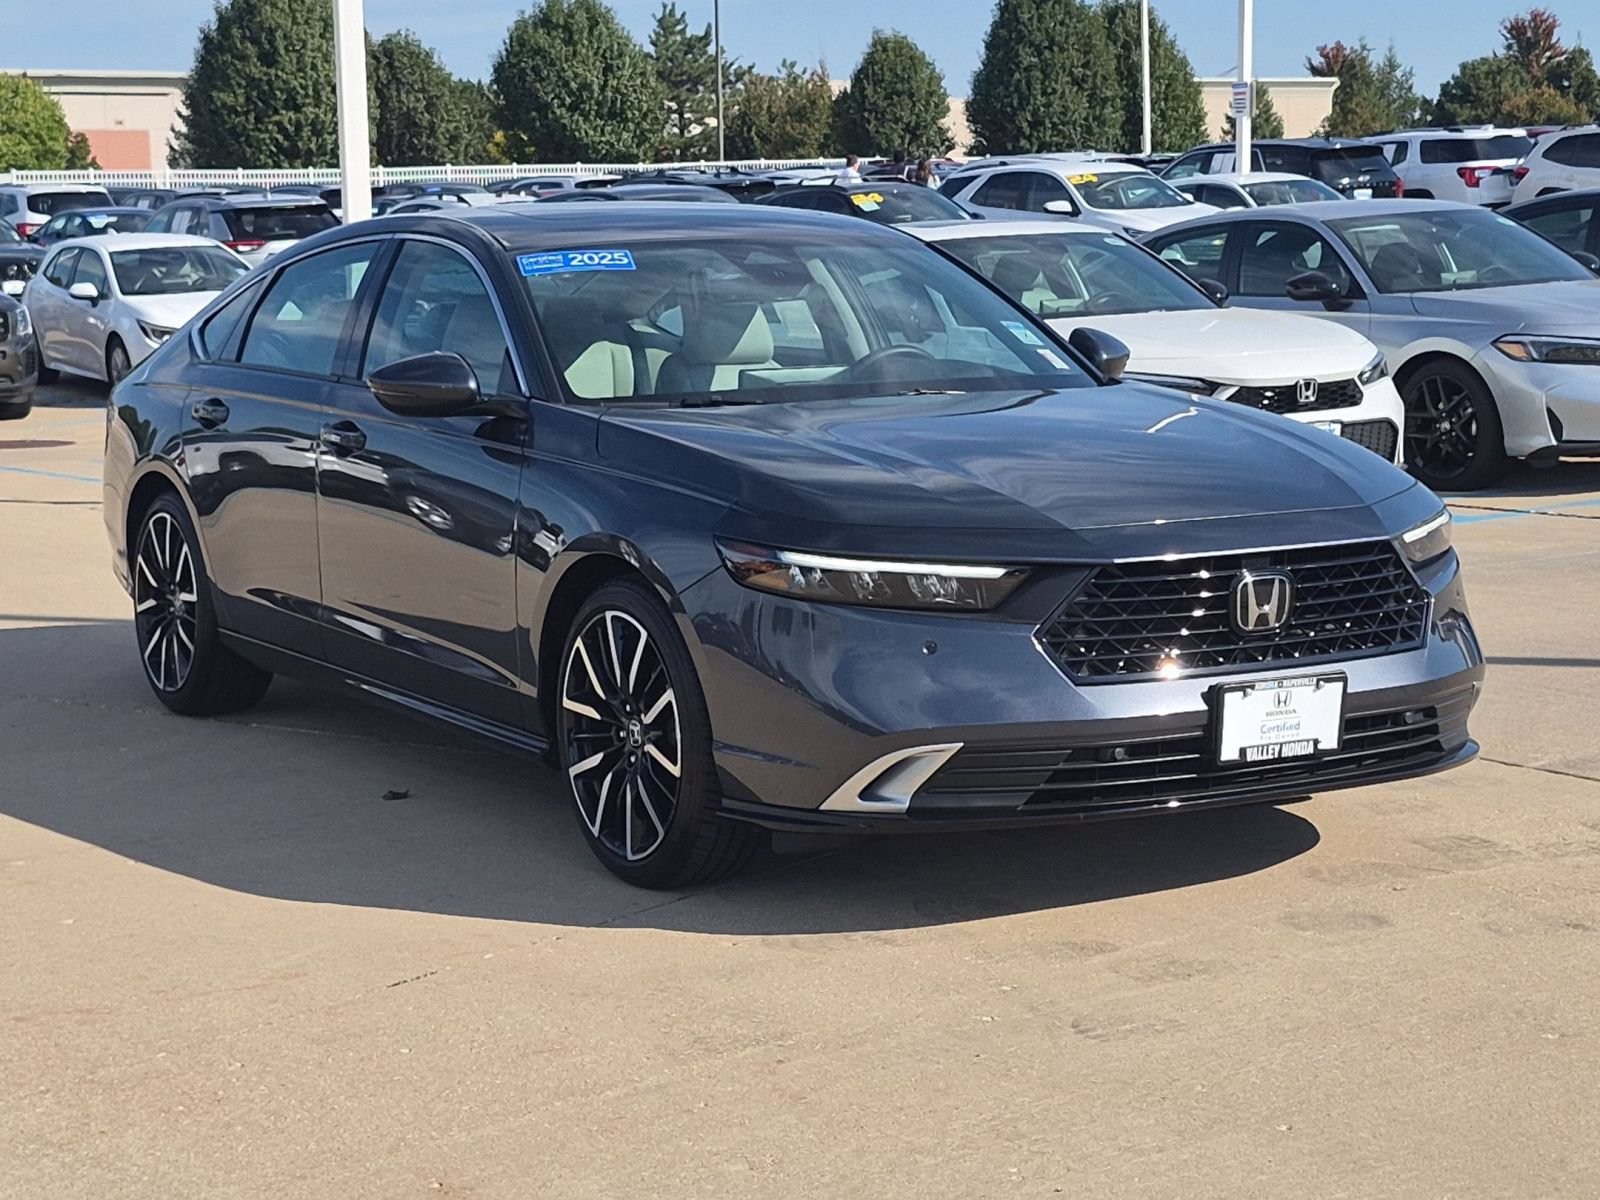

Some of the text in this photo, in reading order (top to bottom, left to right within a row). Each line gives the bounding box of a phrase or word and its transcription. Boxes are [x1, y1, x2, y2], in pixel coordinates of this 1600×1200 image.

[568, 252, 630, 266] 2025
[1265, 708, 1298, 717] HONDA
[1260, 720, 1301, 734] Certified
[1245, 739, 1314, 762] VALLEY HONDA
